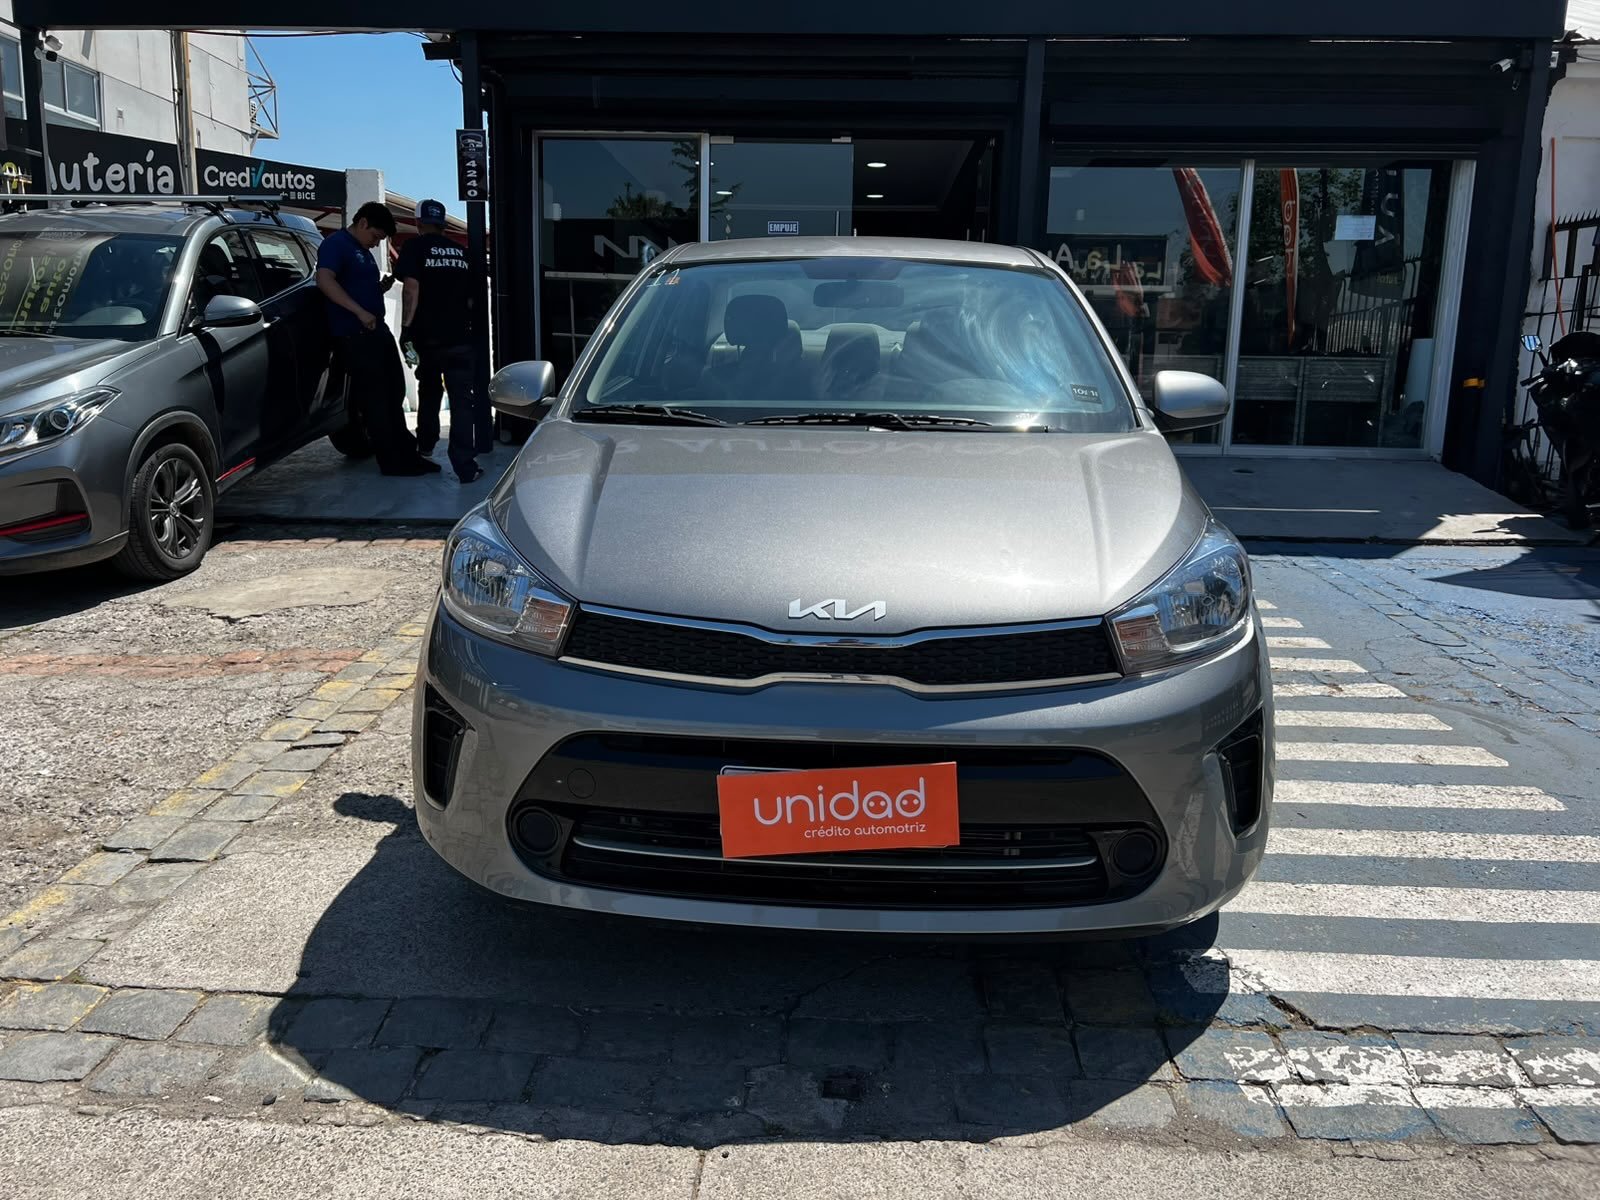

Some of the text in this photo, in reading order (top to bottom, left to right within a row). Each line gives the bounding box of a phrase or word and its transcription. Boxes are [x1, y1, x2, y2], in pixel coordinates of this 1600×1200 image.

[465, 160, 478, 197] 4240
[297, 191, 316, 200] BICE
[769, 223, 797, 232] EMPUJE
[425, 258, 469, 270] MARTIN
[788, 598, 887, 621] KIA
[753, 776, 926, 825] unidad
[803, 822, 926, 839] crédito automotriz
